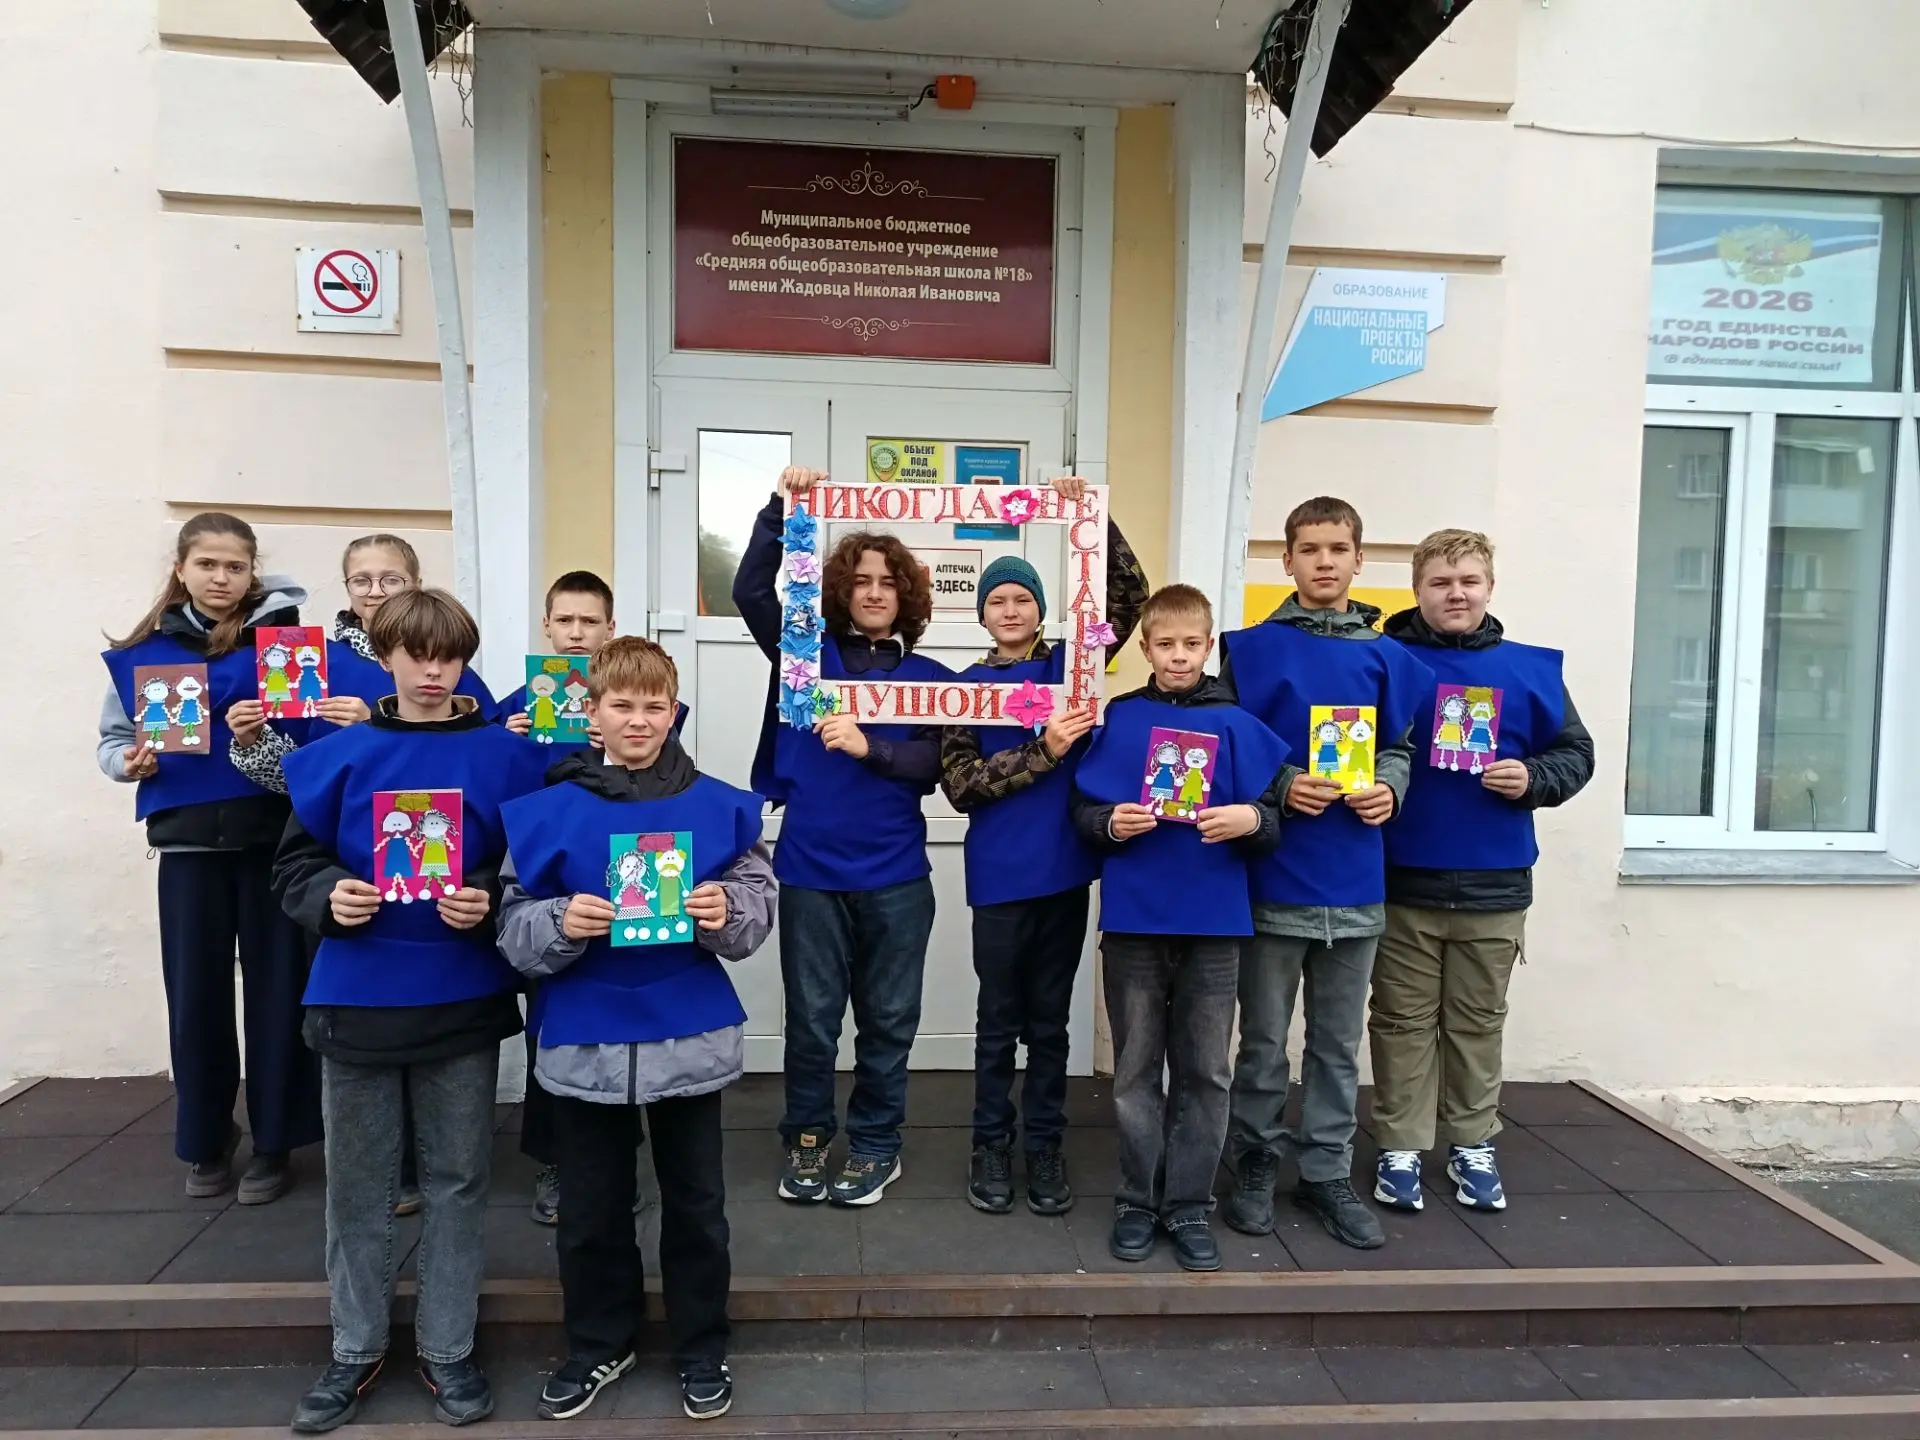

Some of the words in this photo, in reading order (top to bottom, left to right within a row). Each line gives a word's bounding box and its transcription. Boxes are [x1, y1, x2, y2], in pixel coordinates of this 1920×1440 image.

[760, 210, 882, 231] Муниципальное
[885, 216, 971, 235] бюджетное
[732, 232, 904, 255] общеобразовательное
[907, 241, 999, 259] учреждение
[695, 252, 767, 272] «Средняя
[769, 257, 941, 278] общеобразовательная
[944, 266, 992, 280] школа
[994, 267, 1033, 282] №18»
[728, 279, 778, 293] имени
[780, 278, 851, 298] Жадовца
[853, 281, 917, 299] Николая
[919, 285, 1001, 303] Ивановича
[1332, 283, 1430, 300] ОБРАЗОВАНИЕ
[1701, 287, 1814, 312] 2026
[1314, 308, 1426, 330] НАЦИОНАЛЬНЫЕ
[1662, 318, 1712, 333] ГОД
[1719, 321, 1848, 338] ЕДИНСТВА
[1360, 329, 1425, 348] ПРОЕКТЫ
[1768, 339, 1864, 355] РОССИИ
[1371, 348, 1424, 366] РОССИИ
[904, 445, 936, 455] ОБЪЕКТ
[910, 456, 928, 467] ПОД
[901, 468, 937, 478] ОХРАНОЙ
[788, 485, 998, 523] НИКОГДА
[935, 564, 976, 574] АПТЕЧКА
[935, 579, 975, 594] ЗДЕСЬ
[835, 682, 1004, 721] ДУШОЙ
